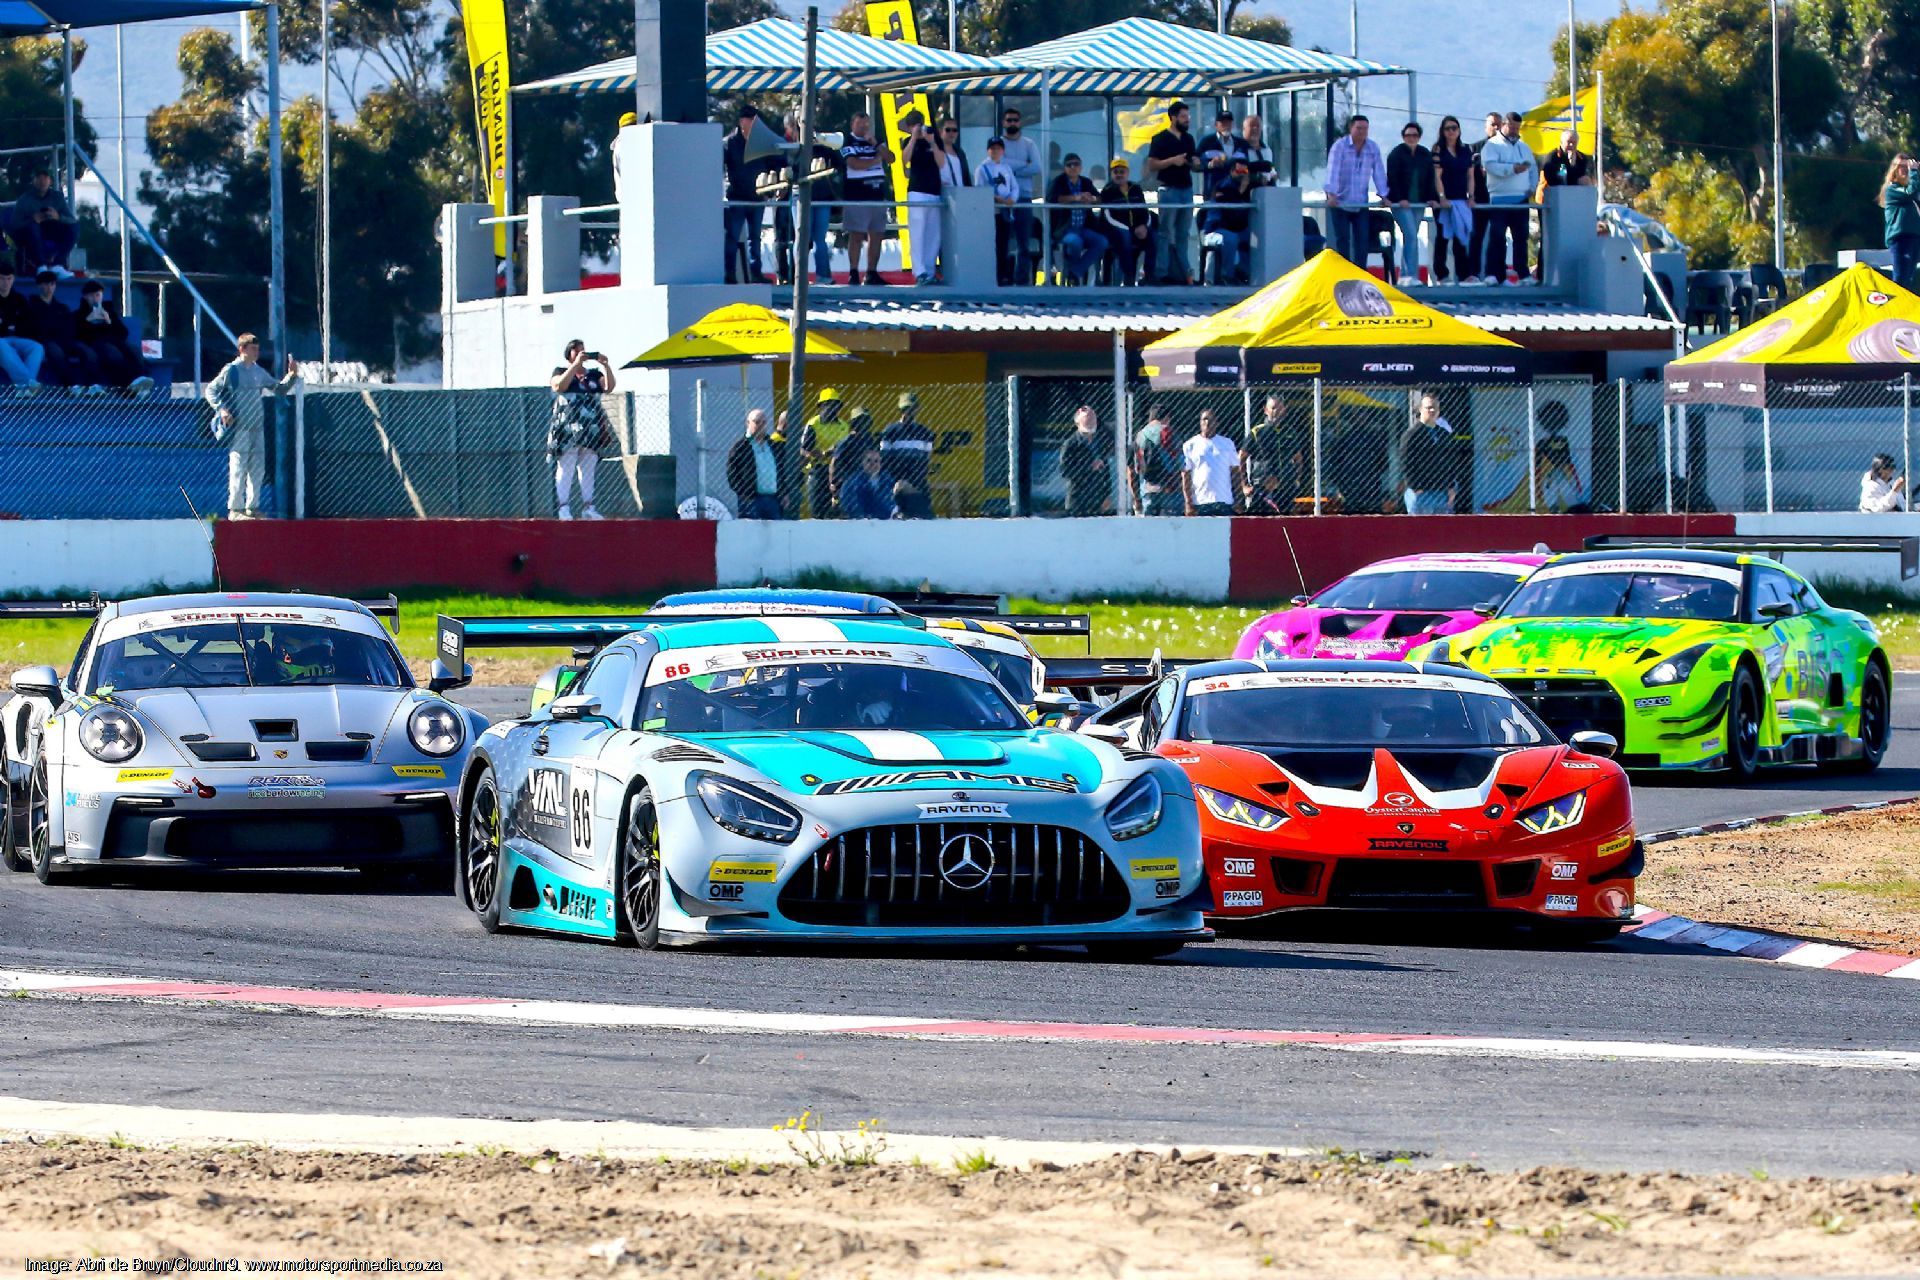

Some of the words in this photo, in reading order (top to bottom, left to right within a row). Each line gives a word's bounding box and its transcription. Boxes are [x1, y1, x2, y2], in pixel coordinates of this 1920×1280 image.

[1337, 318, 1425, 327] DUNLOP
[1363, 363, 1414, 372] FALKEN
[171, 613, 303, 622] SUPERCARS
[743, 648, 893, 661] SUPERCARS
[664, 664, 691, 678] 86
[1276, 676, 1417, 684] SUPERCARS
[1205, 682, 1230, 690] 34
[1635, 697, 1671, 707] sparco
[927, 803, 1001, 814] RAVENOL
[572, 787, 592, 850] 86
[1374, 840, 1444, 849] RAVENOL
[1224, 860, 1255, 874] OMP
[1552, 864, 1578, 878] OMP
[710, 884, 744, 898] OMP
[1155, 880, 1181, 895] OMP
[1232, 891, 1262, 901] PAGID
[1553, 895, 1577, 905] PAGID
